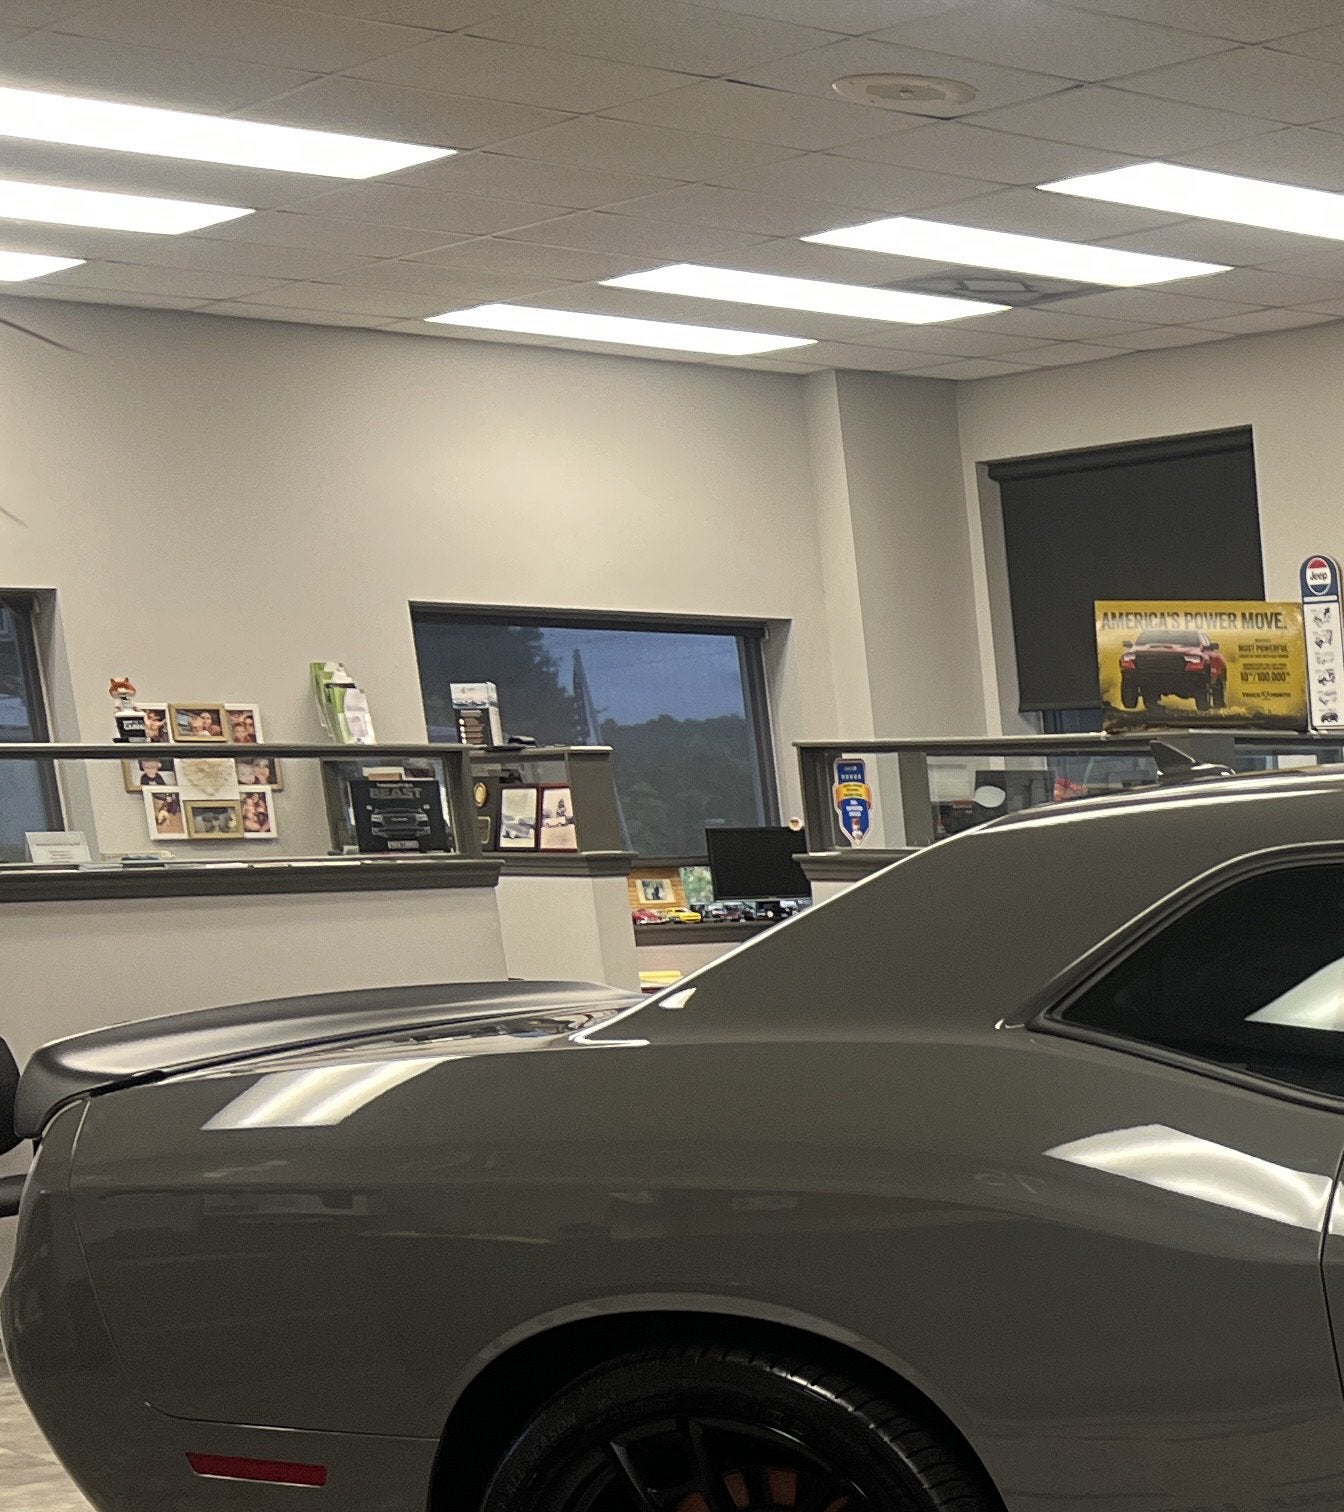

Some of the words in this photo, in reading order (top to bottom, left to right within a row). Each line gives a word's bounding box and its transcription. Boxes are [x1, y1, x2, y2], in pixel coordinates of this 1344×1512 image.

[1309, 570, 1328, 581] Jeep
[1101, 611, 1180, 631] AMERICA'S
[1184, 612, 1238, 631] POWER
[368, 787, 422, 799] BEAST
